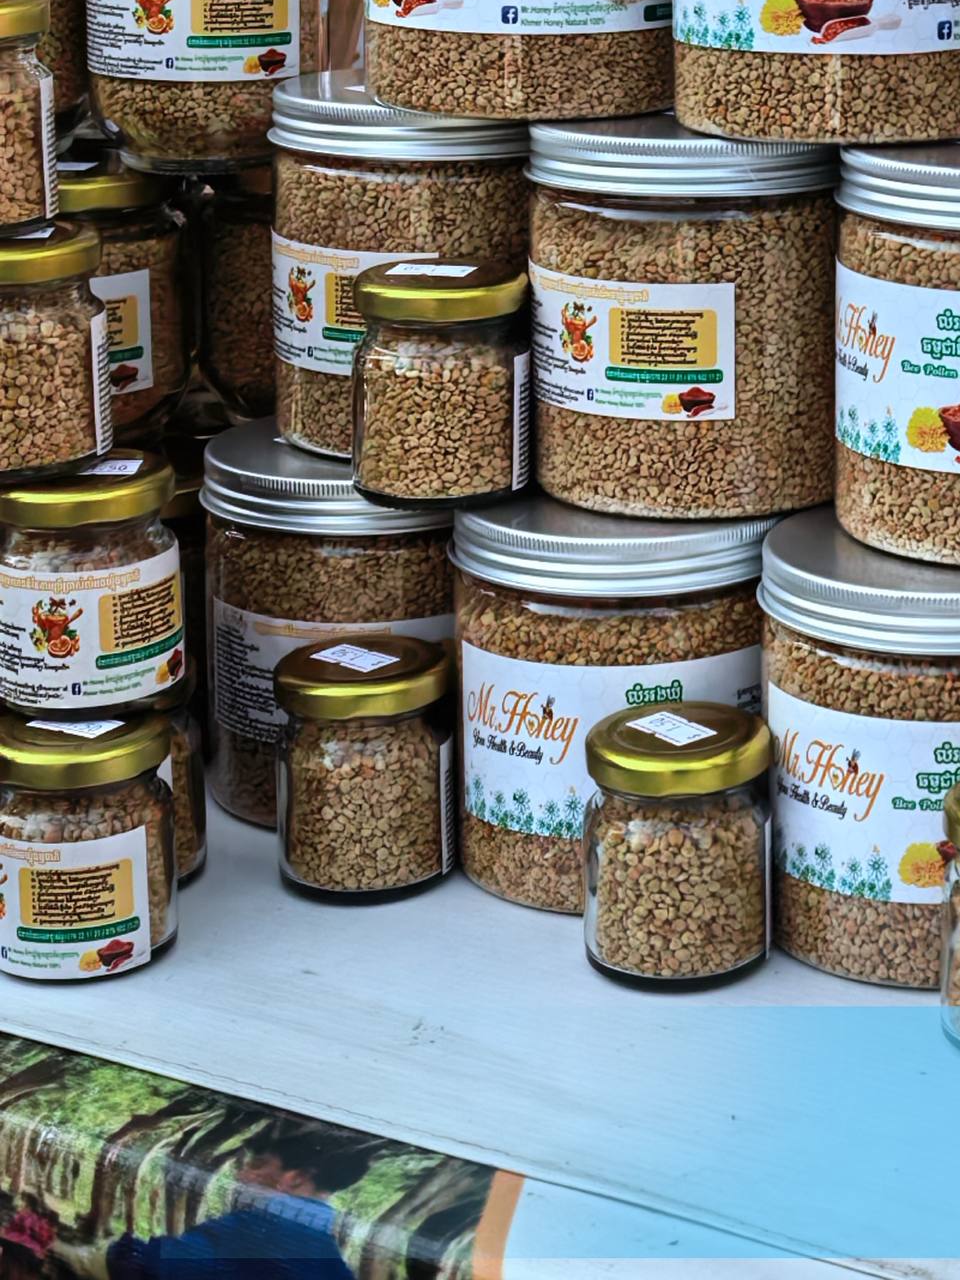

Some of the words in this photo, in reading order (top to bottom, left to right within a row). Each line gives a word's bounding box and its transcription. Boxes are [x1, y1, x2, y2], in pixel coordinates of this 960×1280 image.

[841, 303, 896, 384] Honey
[902, 361, 921, 374] Bee
[924, 364, 957, 378] Pollen
[498, 690, 579, 765] Honey
[515, 742, 544, 765] Beauty
[802, 739, 885, 822] Honey
[818, 794, 848, 820] Beauty
[892, 797, 915, 811] Bee
[919, 797, 944, 811] Poll
